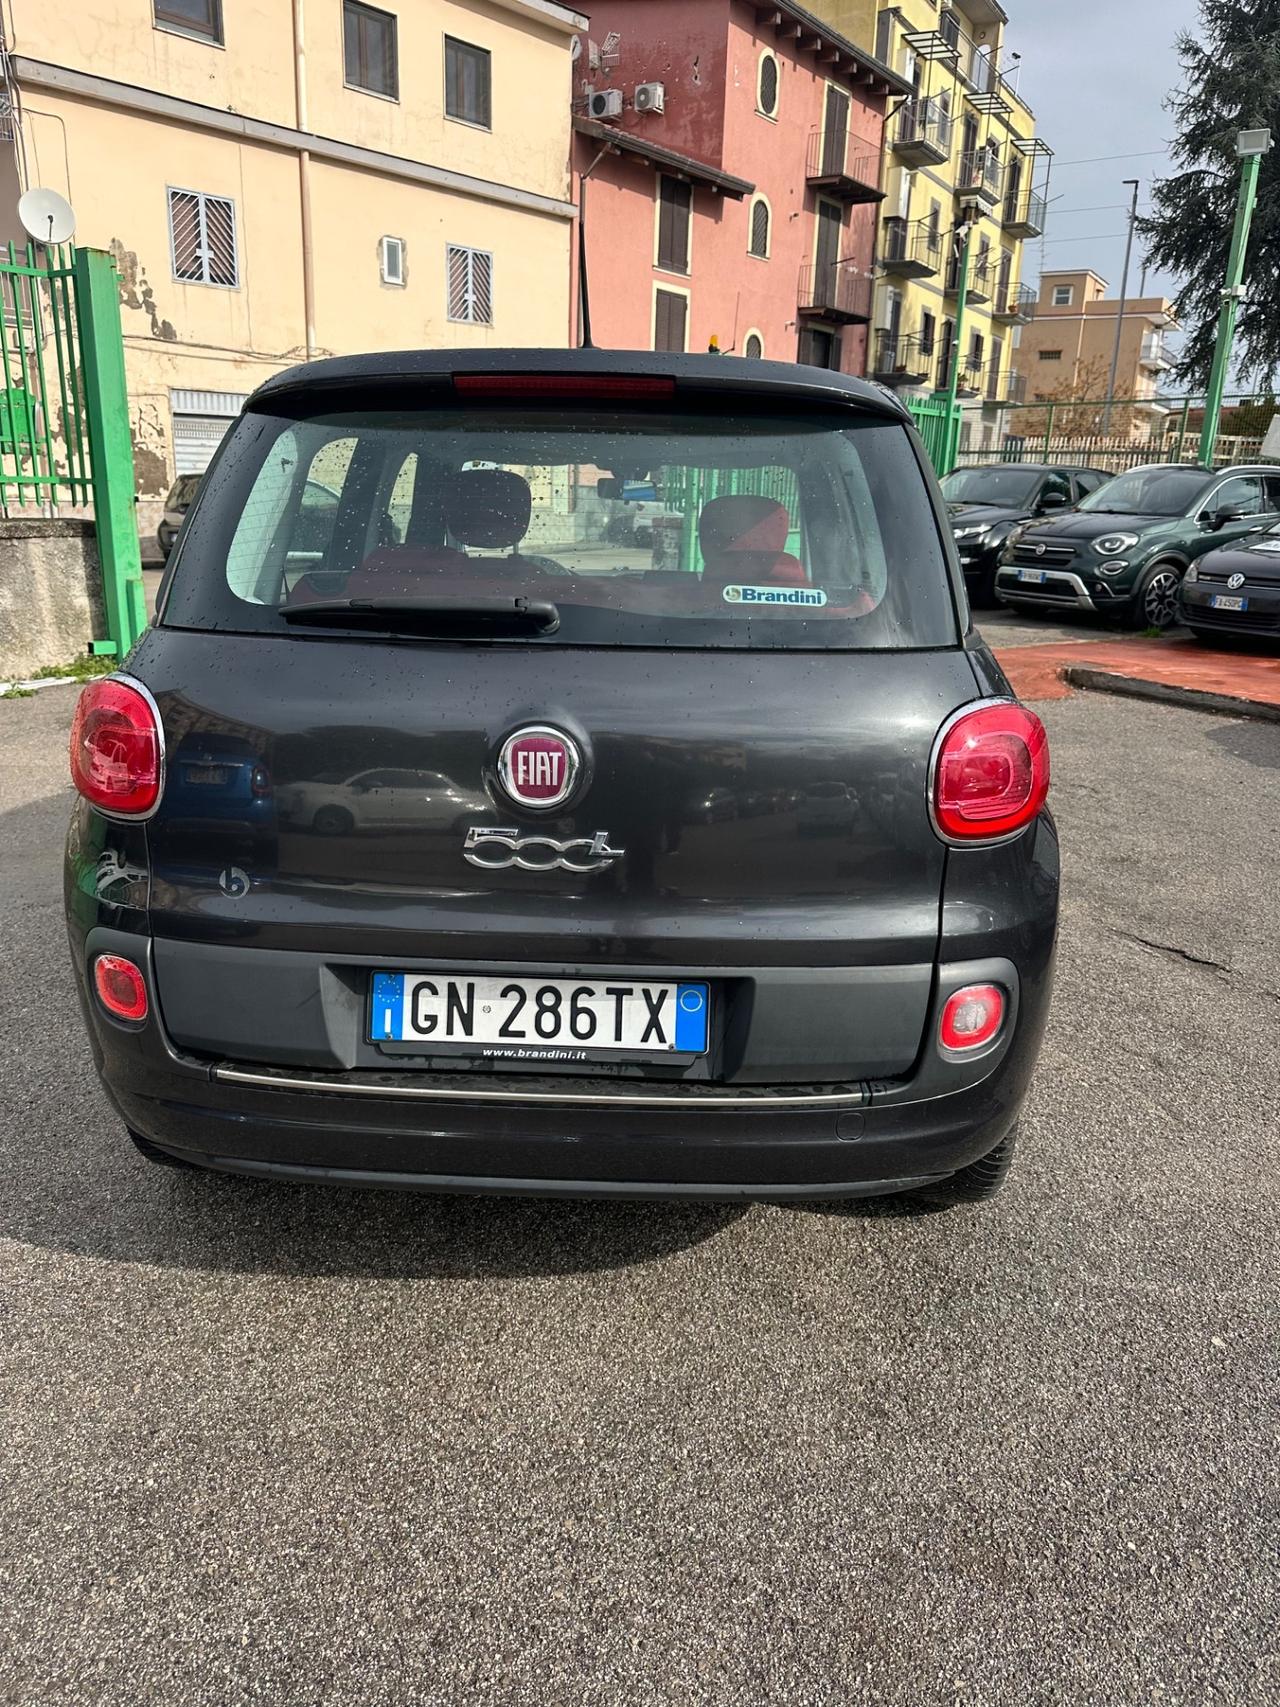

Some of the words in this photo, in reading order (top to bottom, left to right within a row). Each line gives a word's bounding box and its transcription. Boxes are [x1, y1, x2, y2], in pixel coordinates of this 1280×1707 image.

[742, 588, 822, 604] Brandini
[517, 751, 562, 786] FIAT
[463, 827, 625, 873] 500L
[482, 1048, 587, 1060] www.brandini.it
